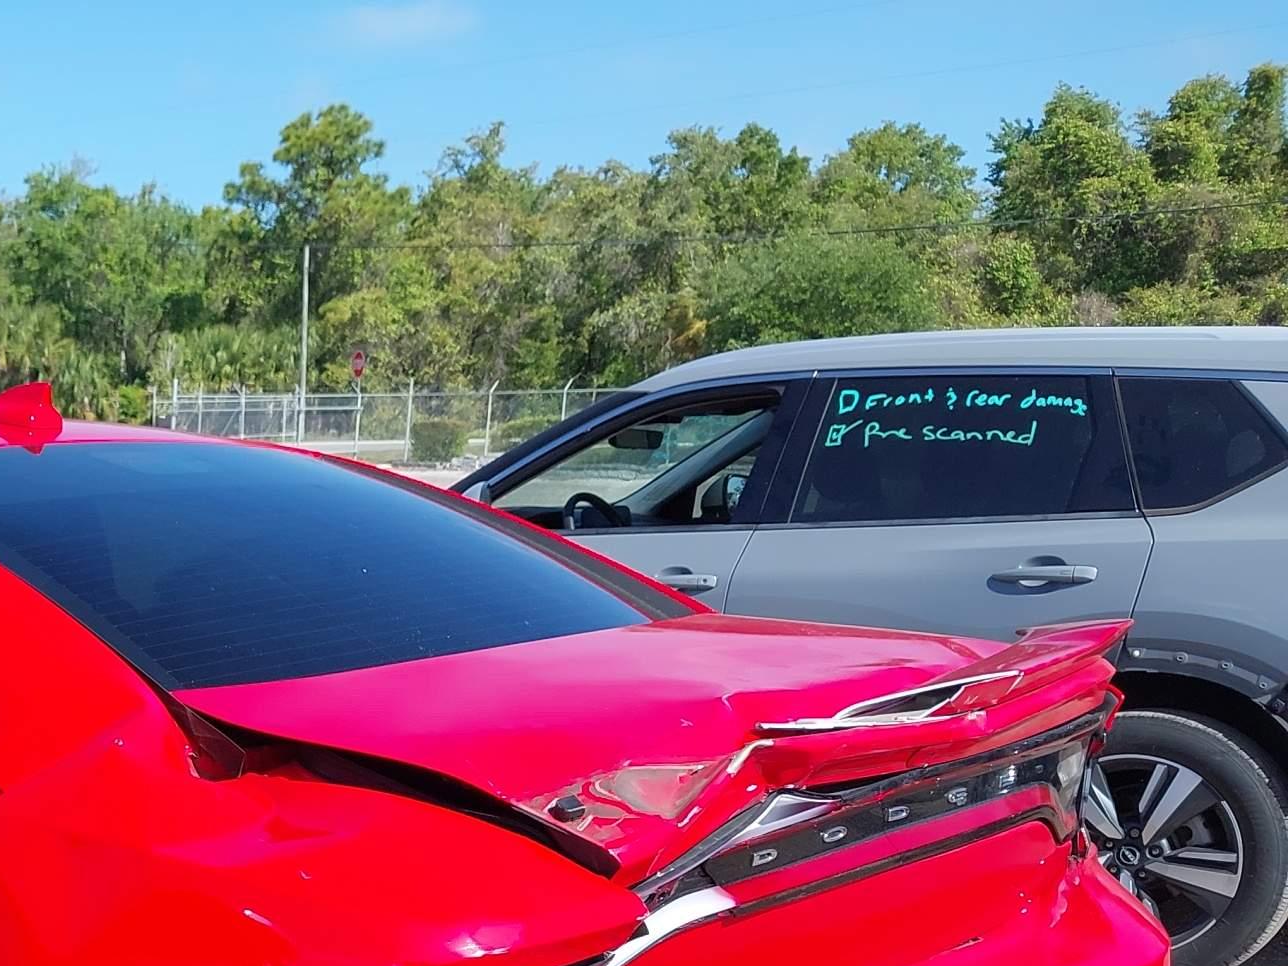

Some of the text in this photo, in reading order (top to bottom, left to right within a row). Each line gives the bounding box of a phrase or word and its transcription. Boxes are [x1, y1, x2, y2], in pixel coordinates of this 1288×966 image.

[865, 388, 934, 410] Front
[965, 389, 1012, 407] rear
[921, 420, 1038, 446] scanned
[751, 765, 1018, 867] DODGE
